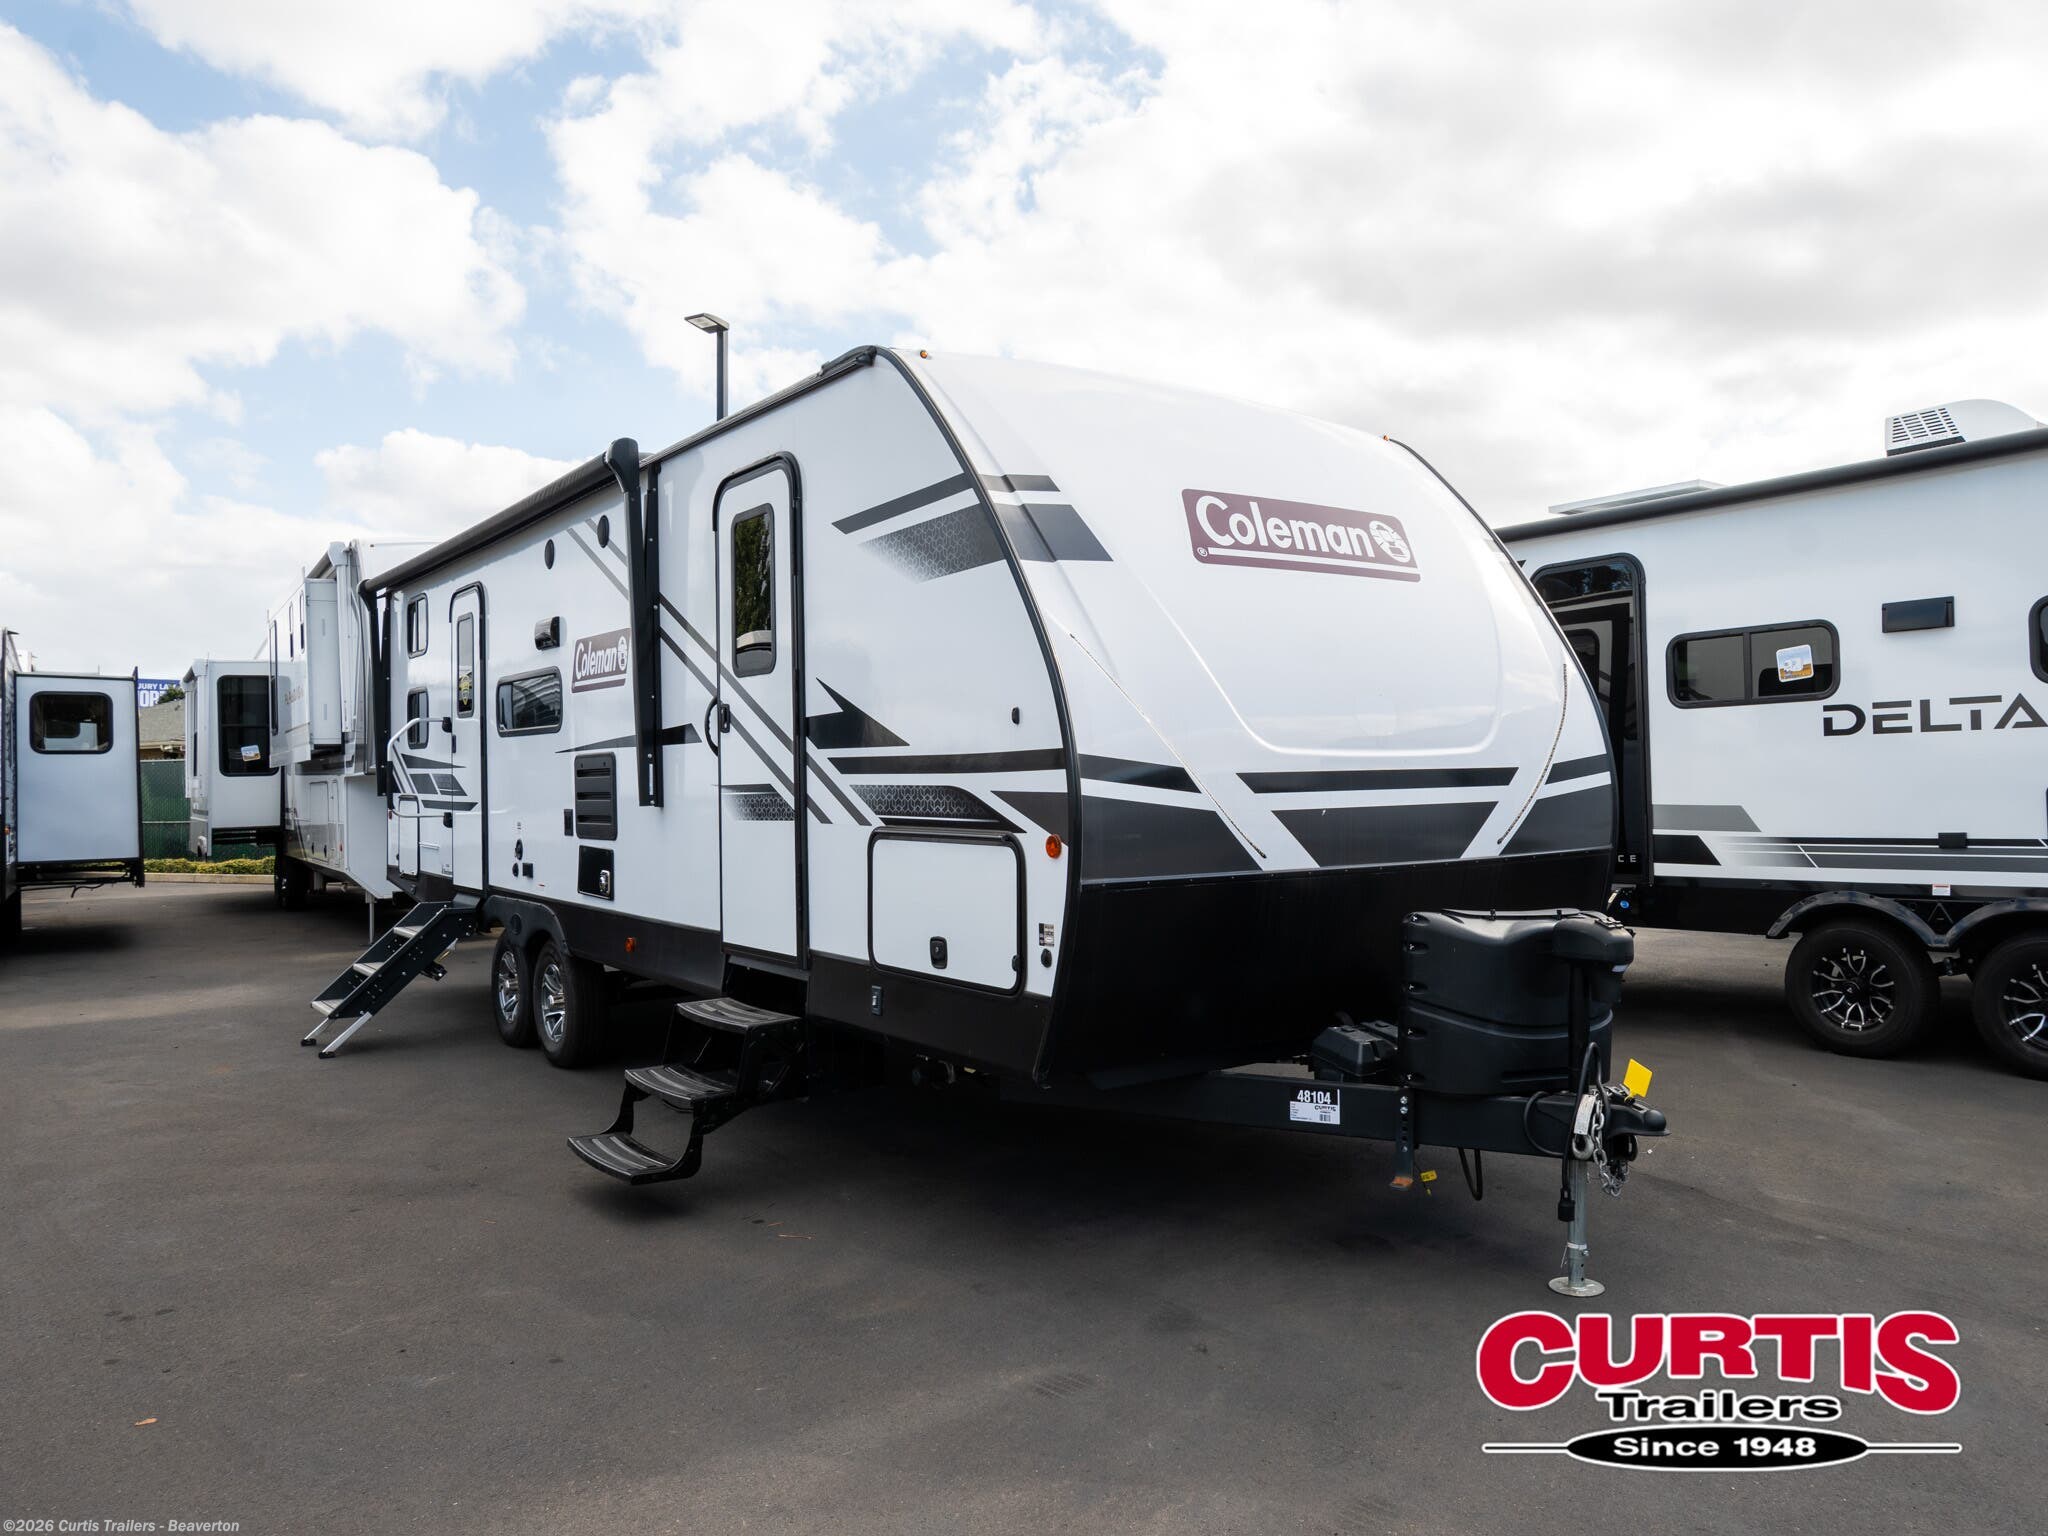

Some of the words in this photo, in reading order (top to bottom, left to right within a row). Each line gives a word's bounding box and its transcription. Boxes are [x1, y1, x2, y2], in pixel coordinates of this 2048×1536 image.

[1195, 494, 1376, 559] Coleman
[575, 641, 618, 680] Coleman
[1822, 692, 2048, 737] DELTA
[1297, 1089, 1331, 1105] 48104
